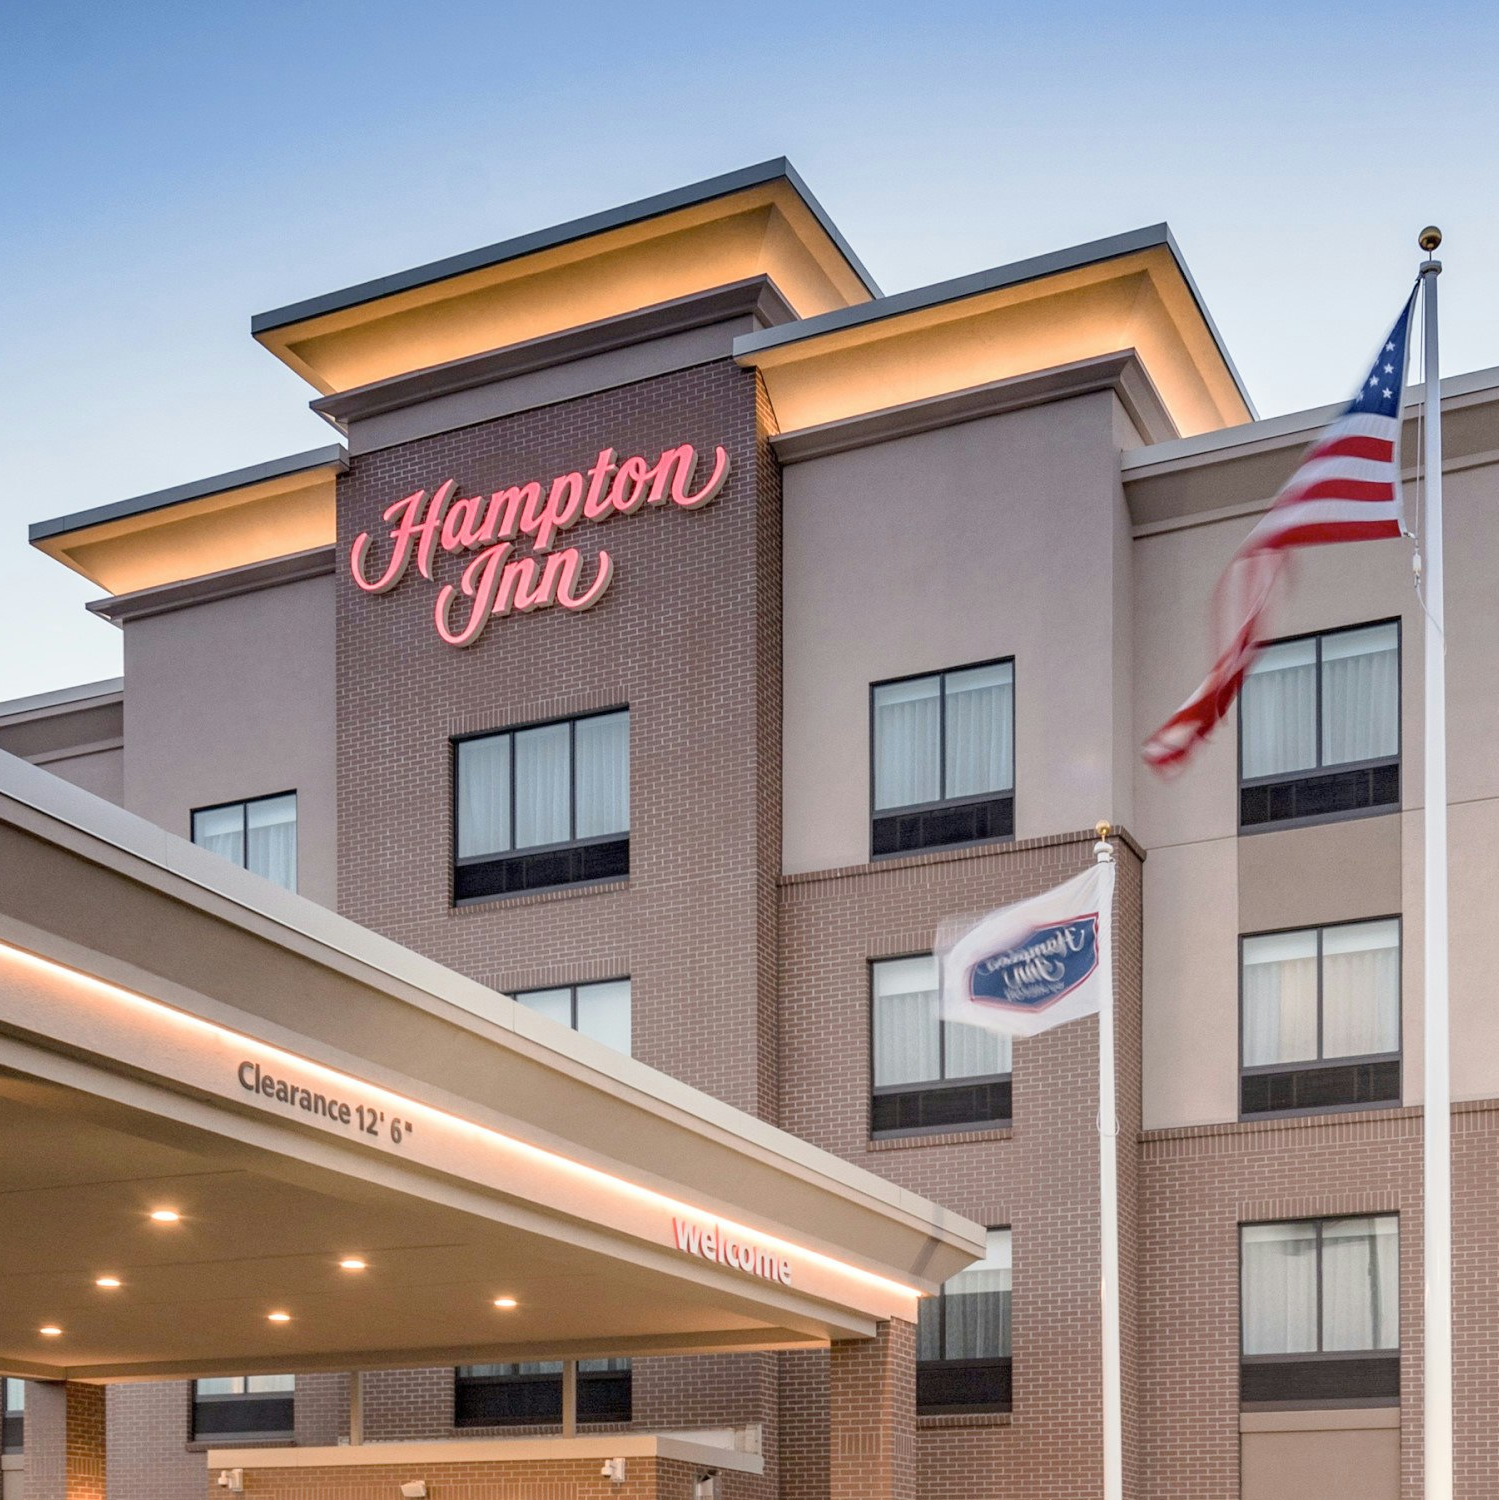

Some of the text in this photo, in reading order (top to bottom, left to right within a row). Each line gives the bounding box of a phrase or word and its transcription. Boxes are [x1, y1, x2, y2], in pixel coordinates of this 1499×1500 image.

[350, 444, 731, 594] Hampton
[434, 541, 613, 647] Inn
[237, 1060, 351, 1125] Clearance
